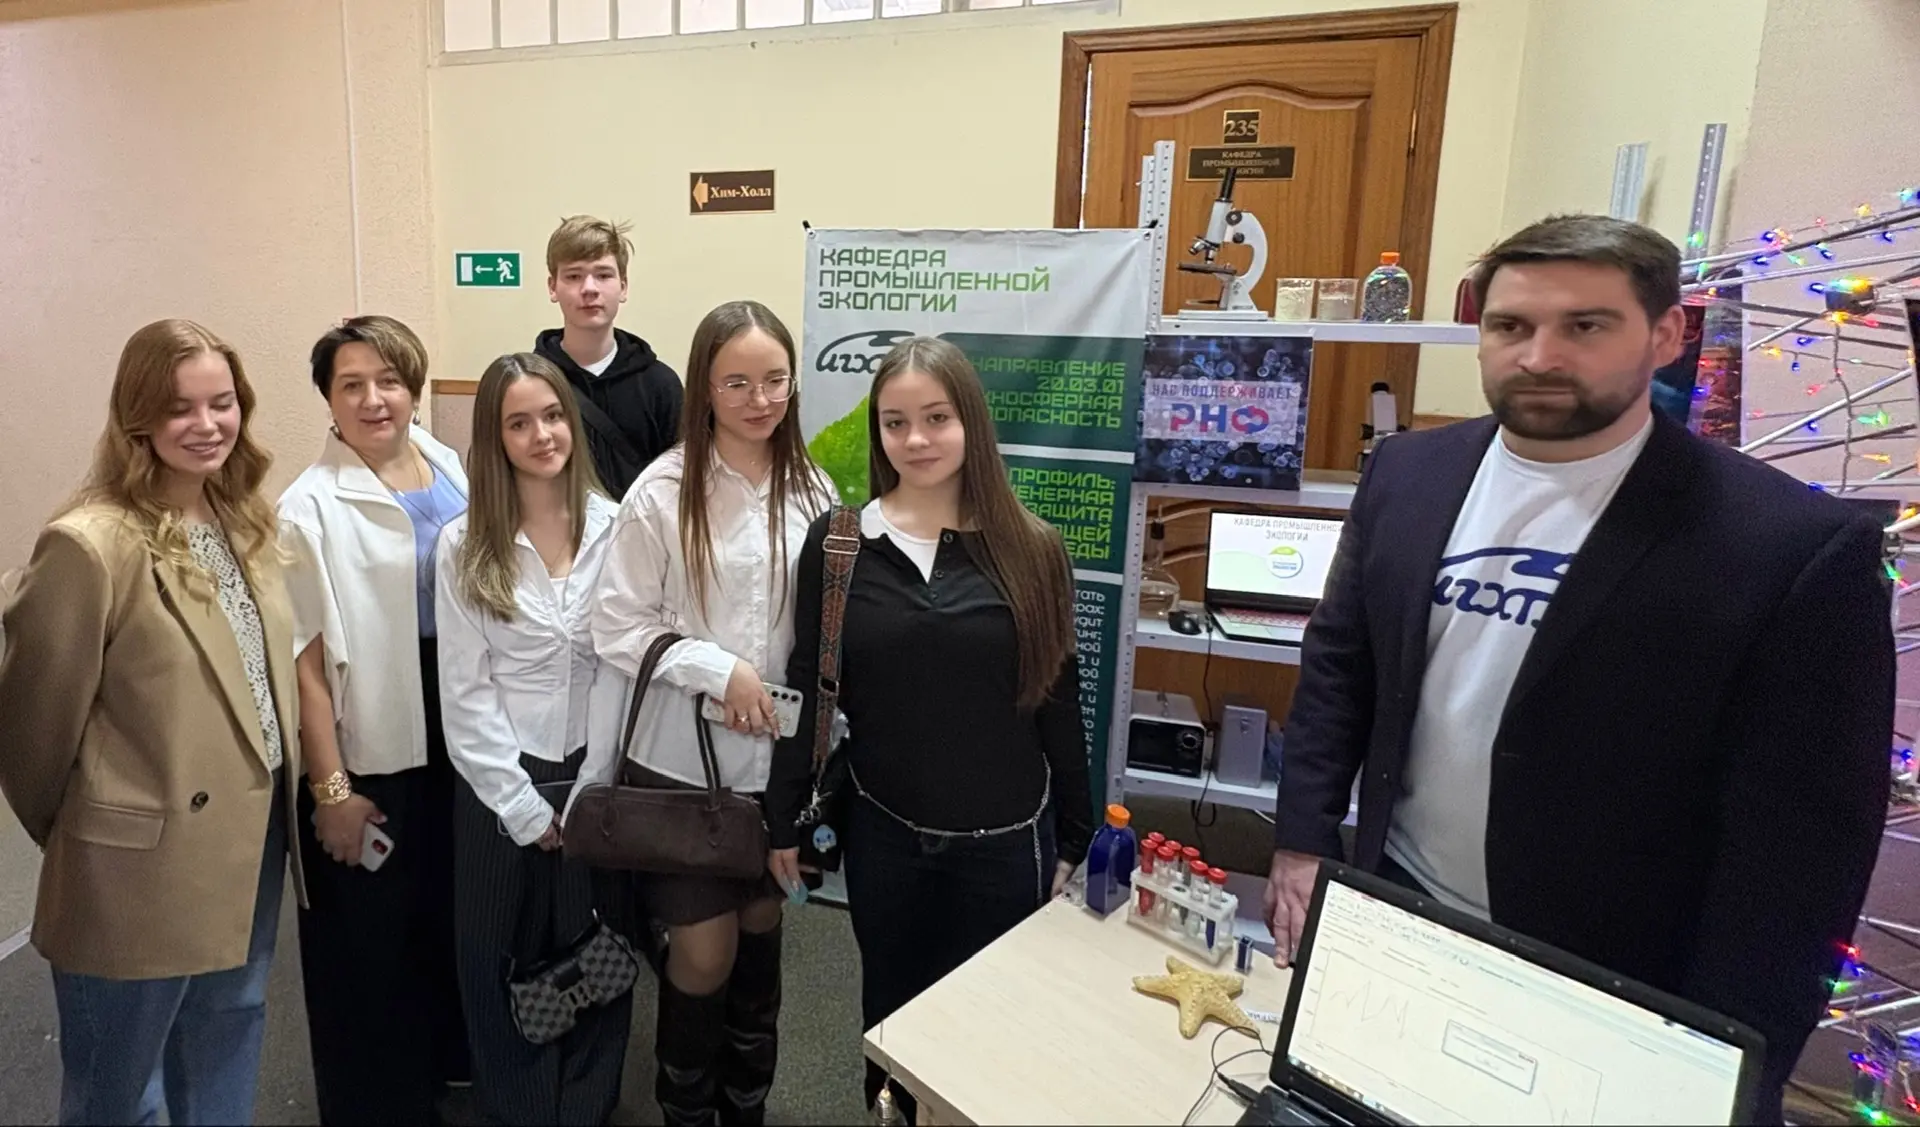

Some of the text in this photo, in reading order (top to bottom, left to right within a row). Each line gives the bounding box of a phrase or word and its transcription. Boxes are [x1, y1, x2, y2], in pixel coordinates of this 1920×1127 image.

[1224, 119, 1260, 136] 235
[710, 185, 772, 199] Хим-Холл
[820, 247, 946, 270] КАФЕДРА
[819, 266, 1050, 292] ПРОМЫШЛЕННОЙ
[818, 291, 957, 313] ЭКОЛОГИИ
[971, 356, 1126, 377] НАПРАВЛЕНИЕ
[1036, 376, 1124, 394] 20.03.01
[1152, 383, 1292, 399] НАС ПОДДЕРЖИВАЕТ
[1170, 403, 1270, 434] РНФ
[1009, 467, 1116, 490] ПРОФИЛЬ:
[1012, 484, 1115, 505] ЕНЕРНАЯ
[1025, 502, 1114, 522] ЗАЩИТА
[1234, 518, 1271, 528] КАФЕДРА
[1266, 530, 1308, 541] ЭКОЛОГИИ
